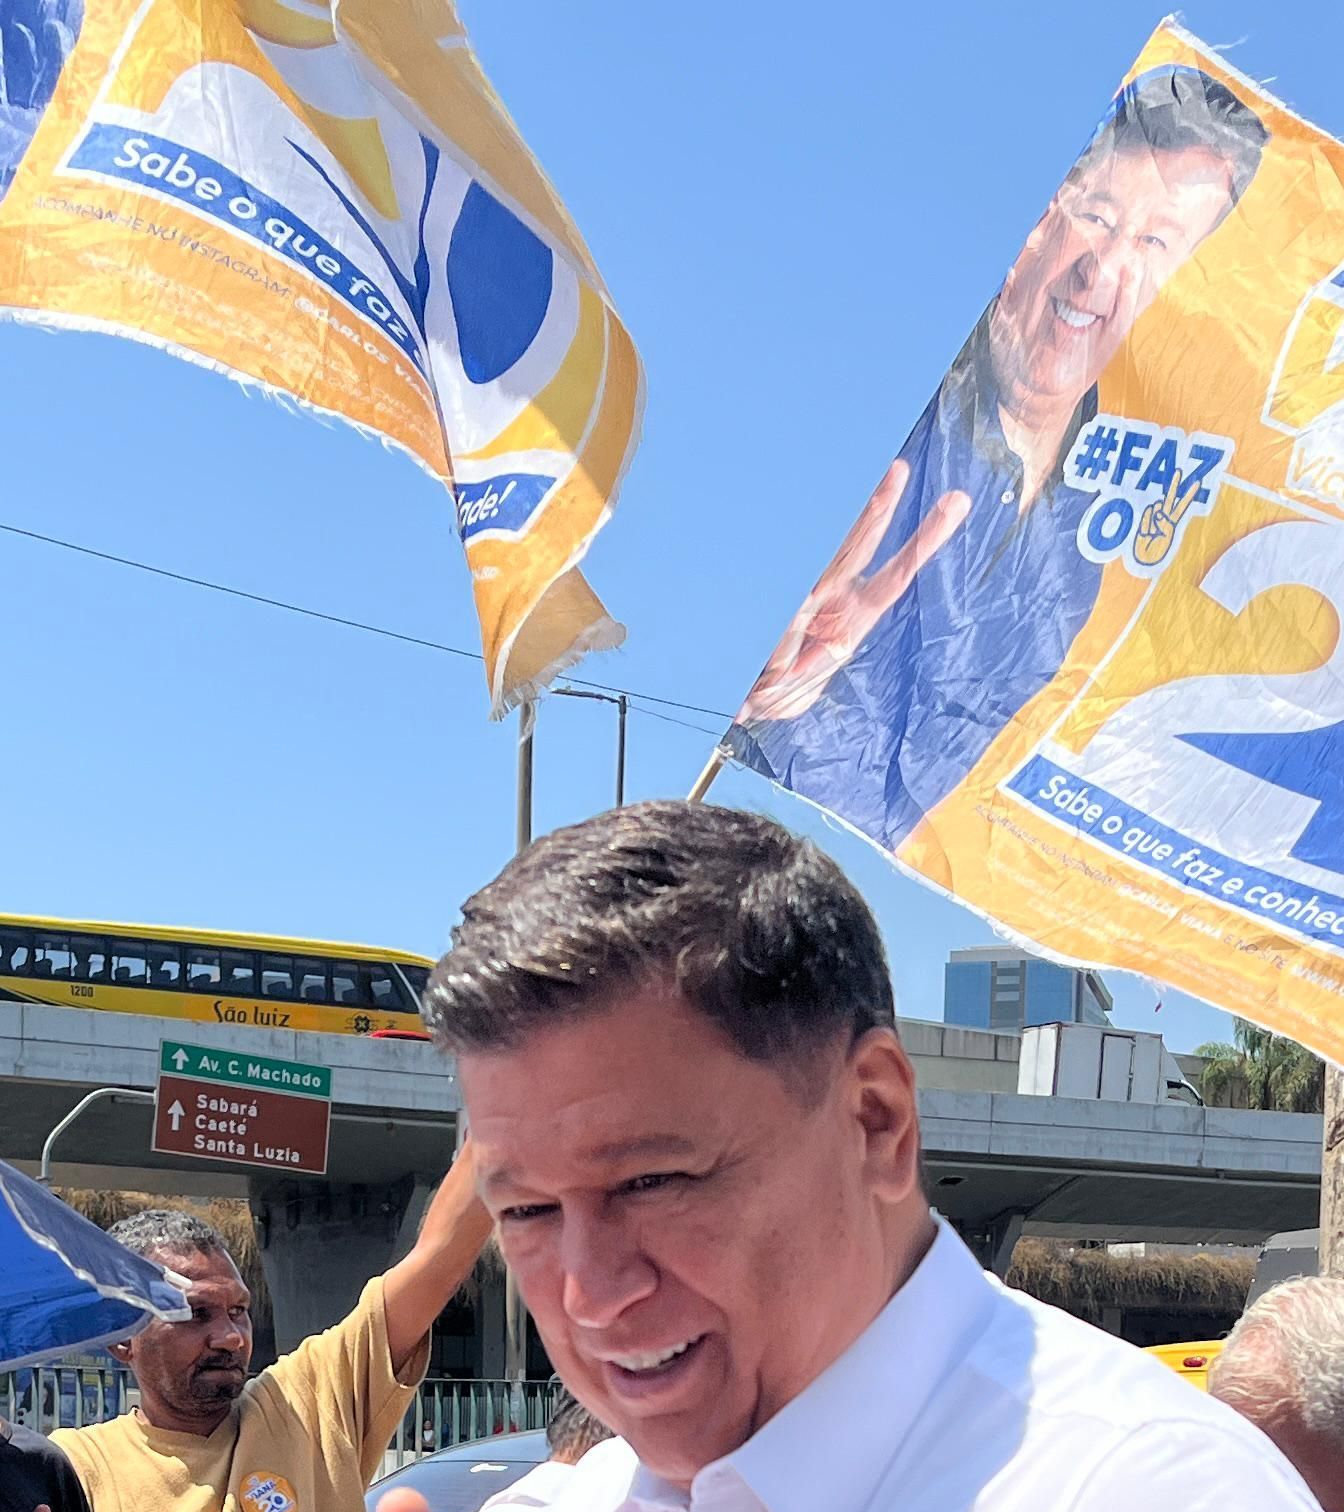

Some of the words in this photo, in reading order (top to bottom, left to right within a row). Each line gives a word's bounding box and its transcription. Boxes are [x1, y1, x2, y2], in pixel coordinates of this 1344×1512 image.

[114, 138, 222, 200] Sabe
[229, 197, 257, 219] o
[265, 217, 341, 276] que
[348, 276, 408, 340] faz
[1075, 426, 1225, 504] #FAZ
[1040, 776, 1103, 824] Sabe
[1102, 816, 1123, 834] o
[1122, 826, 1173, 860] que
[1172, 848, 1224, 886] faz
[1222, 877, 1244, 894] e
[1180, 911, 1224, 938] VIANA
[70, 985, 94, 998] 1200
[213, 1000, 247, 1024] São
[198, 1055, 222, 1074] Av.
[228, 1060, 243, 1076] C.
[248, 1063, 322, 1089] Machado
[197, 1094, 258, 1117] Sabará
[195, 1115, 247, 1135] Caeté
[194, 1135, 245, 1156] Santa
[254, 1143, 300, 1164] Luzia
